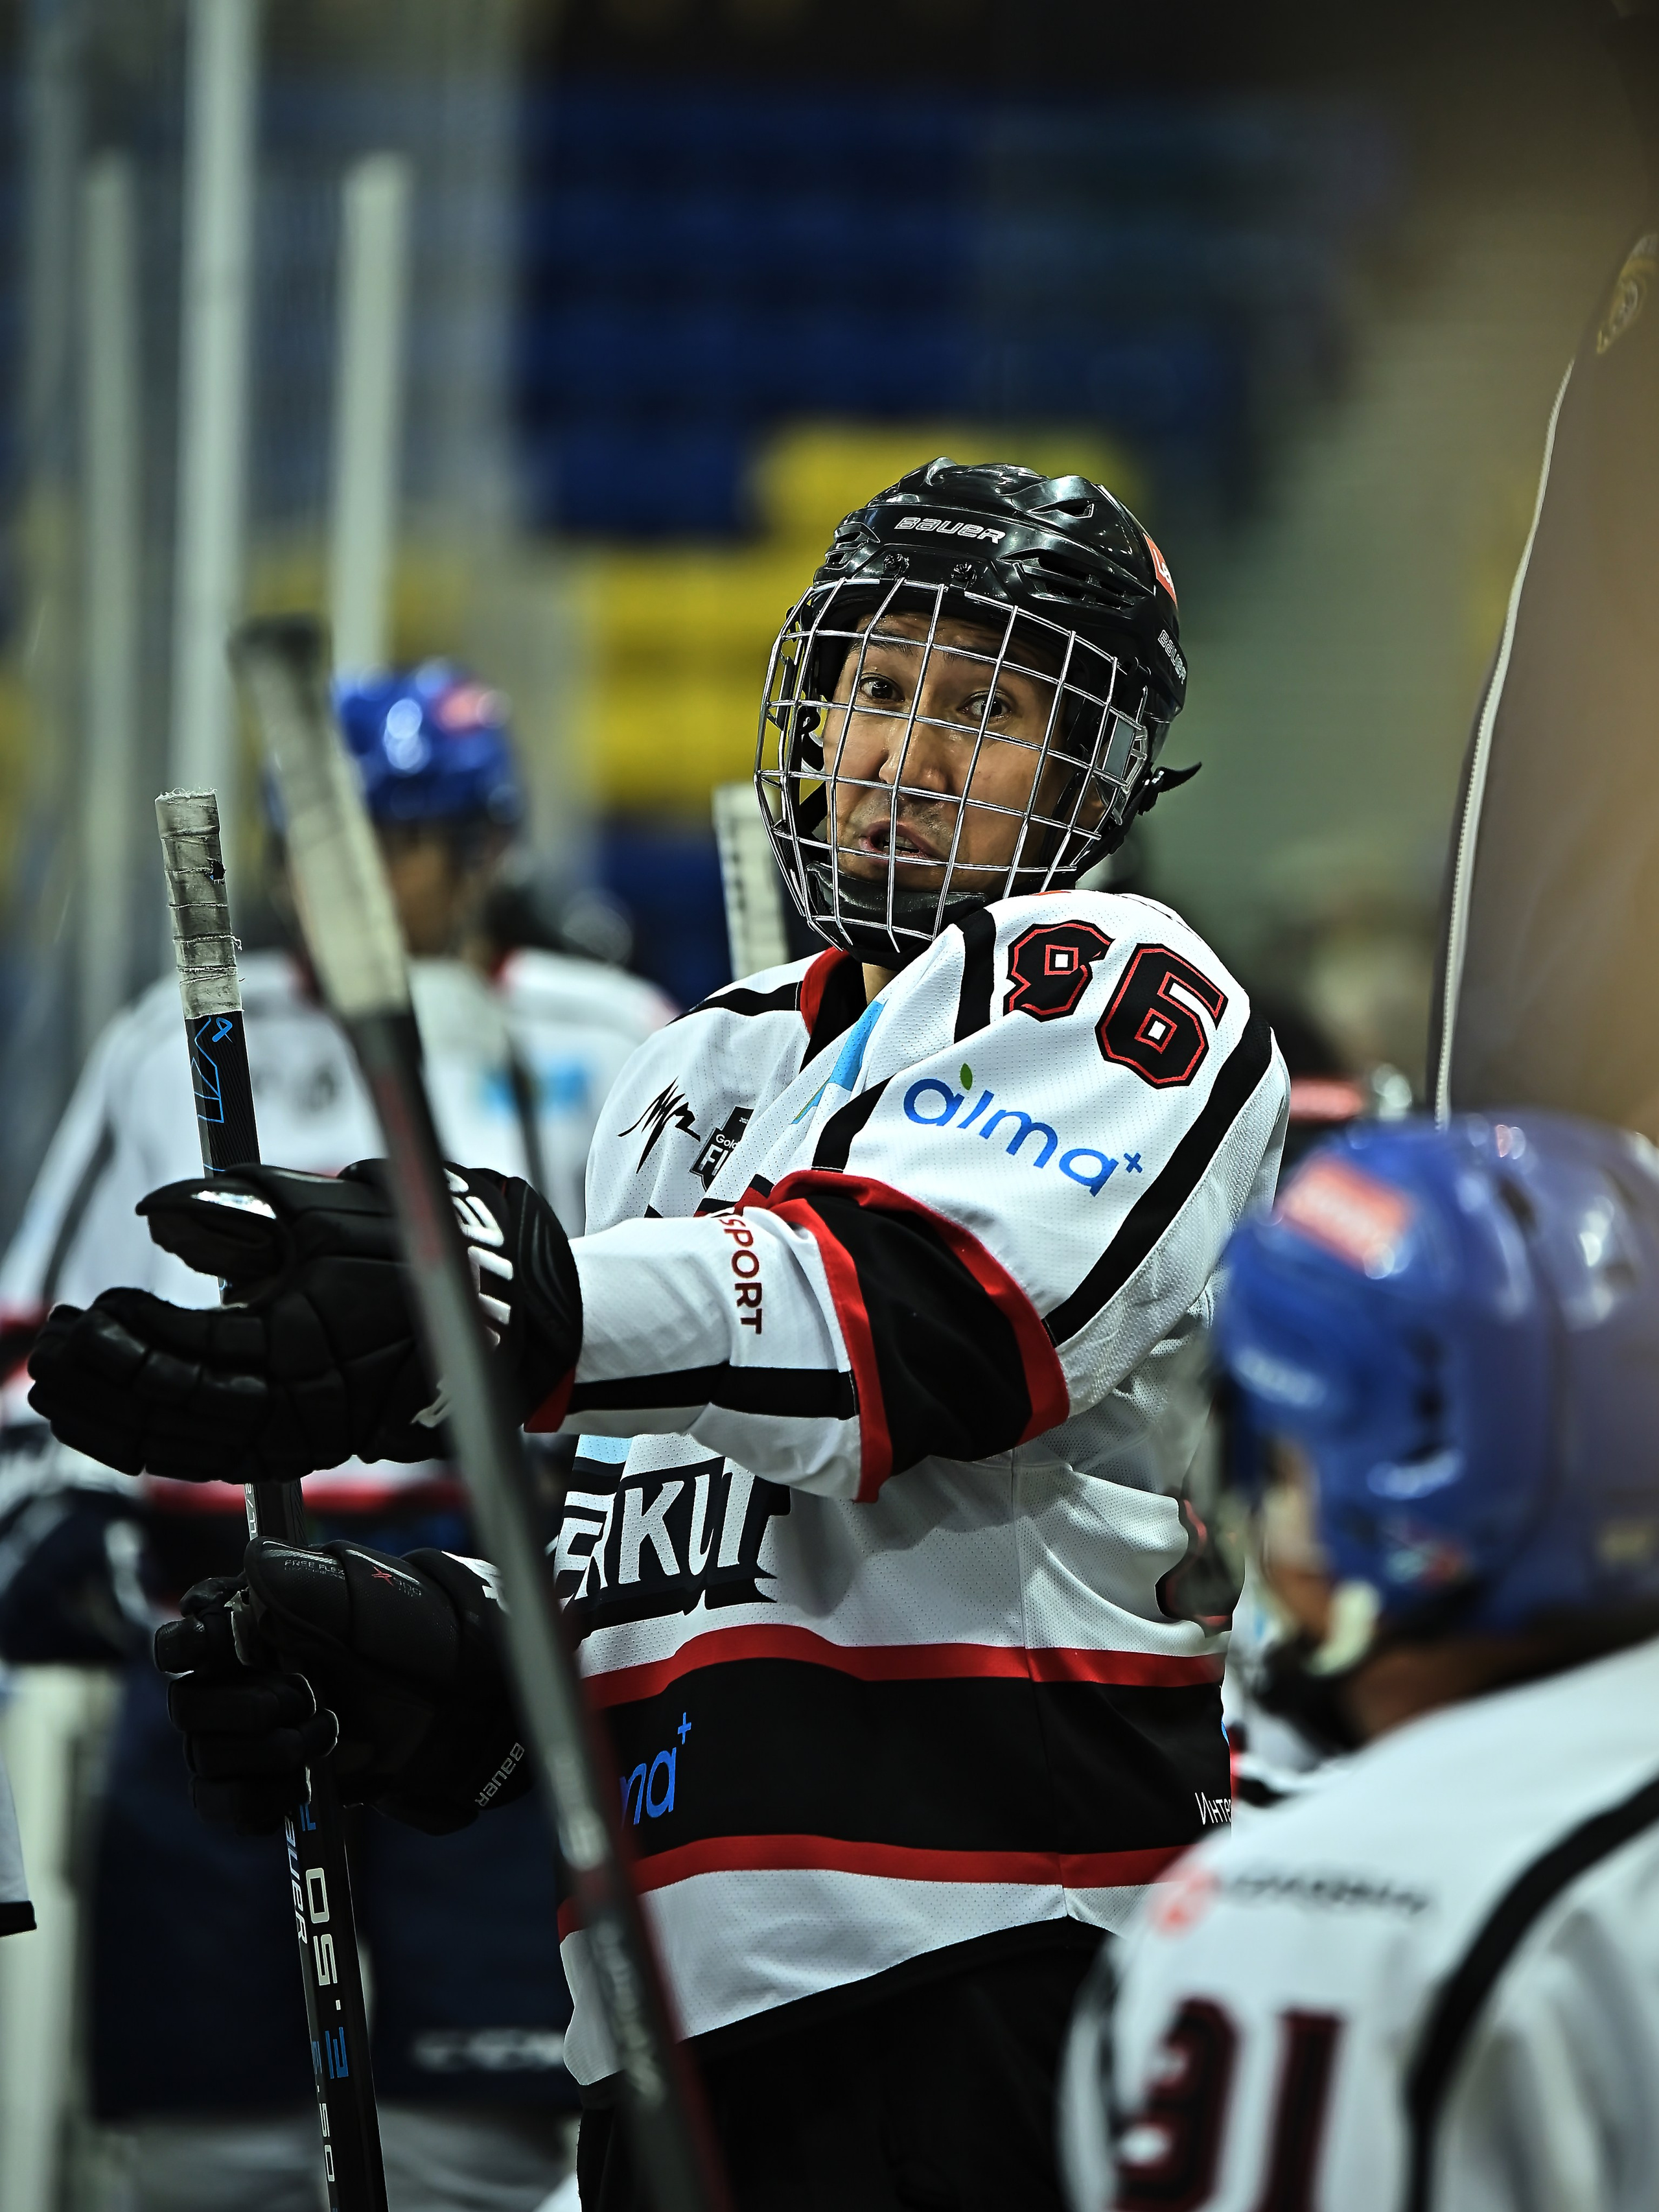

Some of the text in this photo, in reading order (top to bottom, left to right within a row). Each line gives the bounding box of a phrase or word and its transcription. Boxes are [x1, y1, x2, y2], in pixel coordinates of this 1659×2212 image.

[894, 517, 1006, 544] BAUER
[718, 1213, 763, 1335] SPORT
[284, 1815, 308, 1944] AUER
